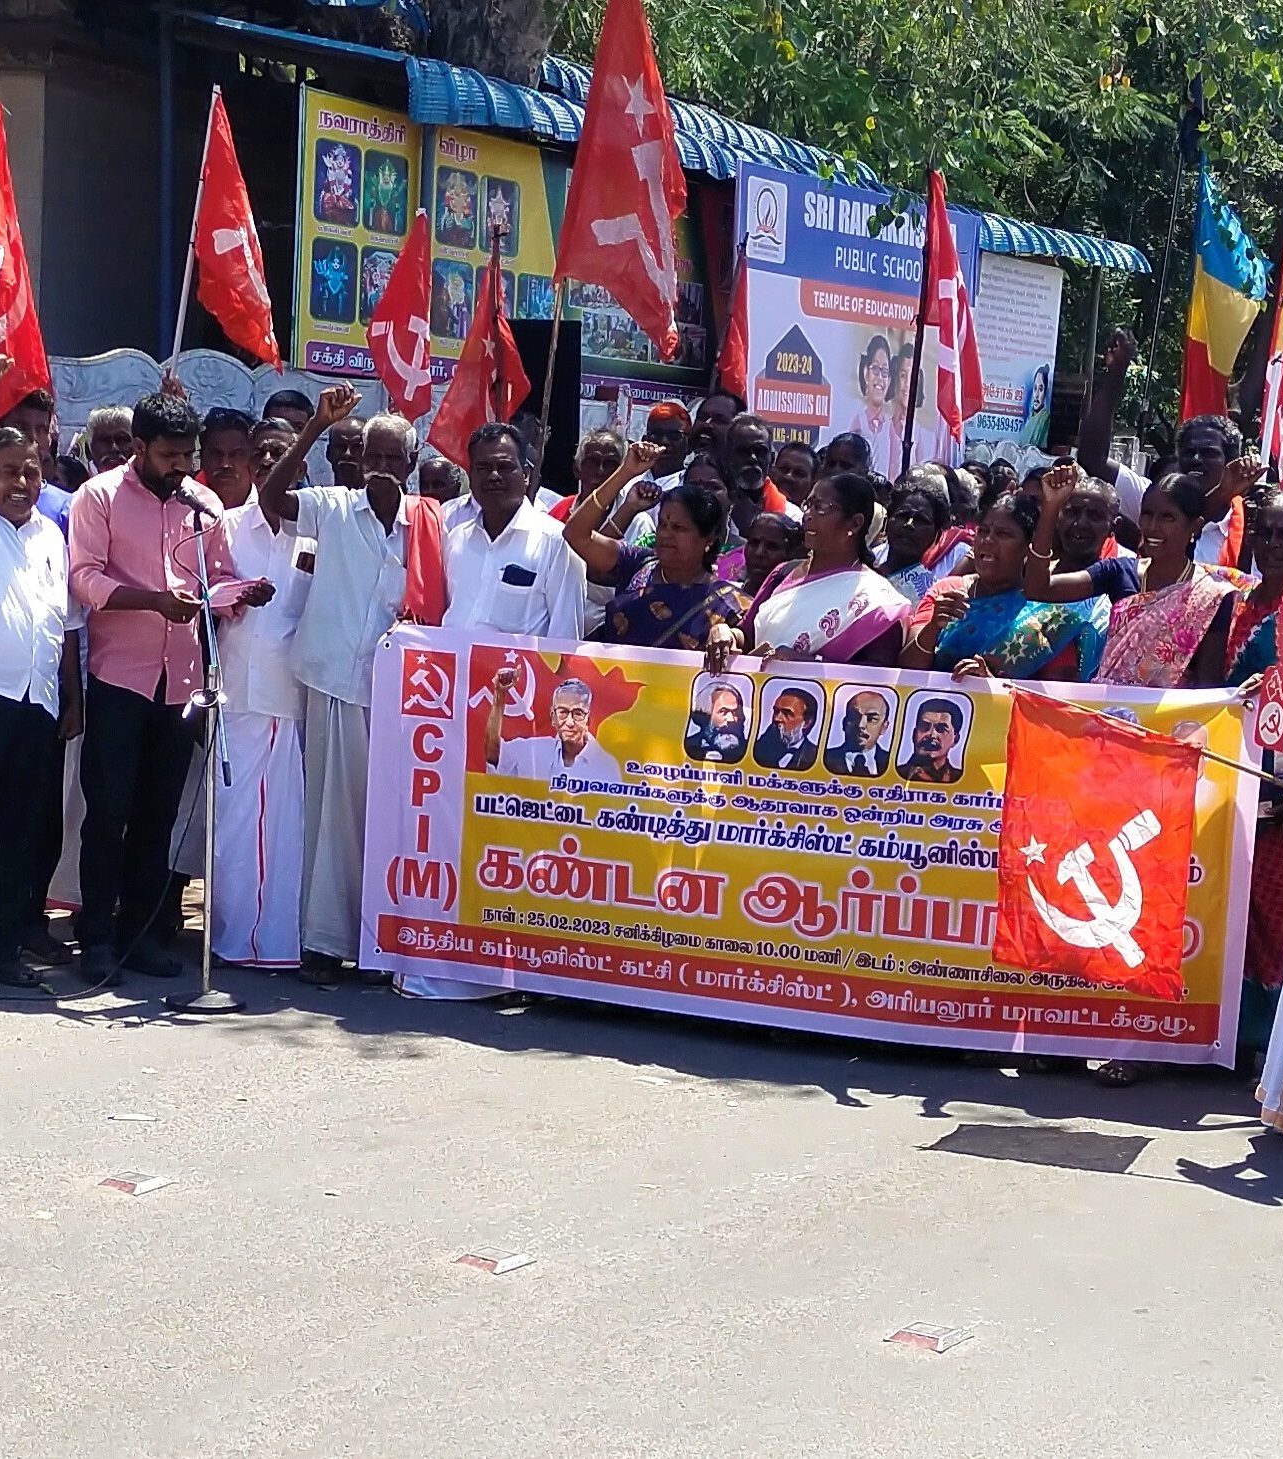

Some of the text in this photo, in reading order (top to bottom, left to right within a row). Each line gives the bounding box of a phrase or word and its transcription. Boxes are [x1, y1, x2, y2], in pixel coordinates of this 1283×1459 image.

[317, 109, 479, 163] நவராத்திரி விழா
[803, 191, 835, 231] SRI
[834, 246, 921, 283] PUBLIC SCHOO
[813, 290, 915, 321] TEMPLE OF EDUCATION
[311, 346, 345, 369] சக்தி
[776, 351, 813, 376] 2023-24
[756, 388, 829, 417] ADMISSIONS ON
[550, 773, 727, 808] நிறுவனங்களுக்கு
[731, 793, 839, 818] ஆதரவாக
[843, 805, 924, 827] ஒன்றிய
[929, 813, 985, 833] அரசு
[625, 761, 743, 785] உழைப்பாளி
[748, 773, 863, 799] மக்களுக்கு
[868, 781, 947, 804] எதிராக
[475, 795, 592, 826] பட்ஜெட்டை
[597, 805, 711, 844] கண்டித்து
[717, 820, 853, 855] மார்க்சிஸ்ட்
[479, 837, 999, 946] கண்டன ஆர்ப்பா
[482, 906, 516, 924] நாள்
[527, 911, 611, 936] 25.02.2023
[613, 923, 702, 948] சனிக்கிழமை
[704, 938, 754, 954] காலை
[756, 942, 801, 960] 10.00
[804, 947, 843, 965] மணி
[855, 952, 896, 971] இடம்
[907, 959, 1026, 985] அண்ணாசிலை
[397, 926, 474, 953] இந்திய
[480, 937, 614, 974] கம்யூனிஸ்ட்
[619, 958, 672, 981] கட்சி
[695, 967, 834, 1002] மார்க்சிஸ்ட்
[865, 988, 995, 1023] அரியலூர்
[1002, 1004, 1196, 1038] மாவட்டக்குழு.
